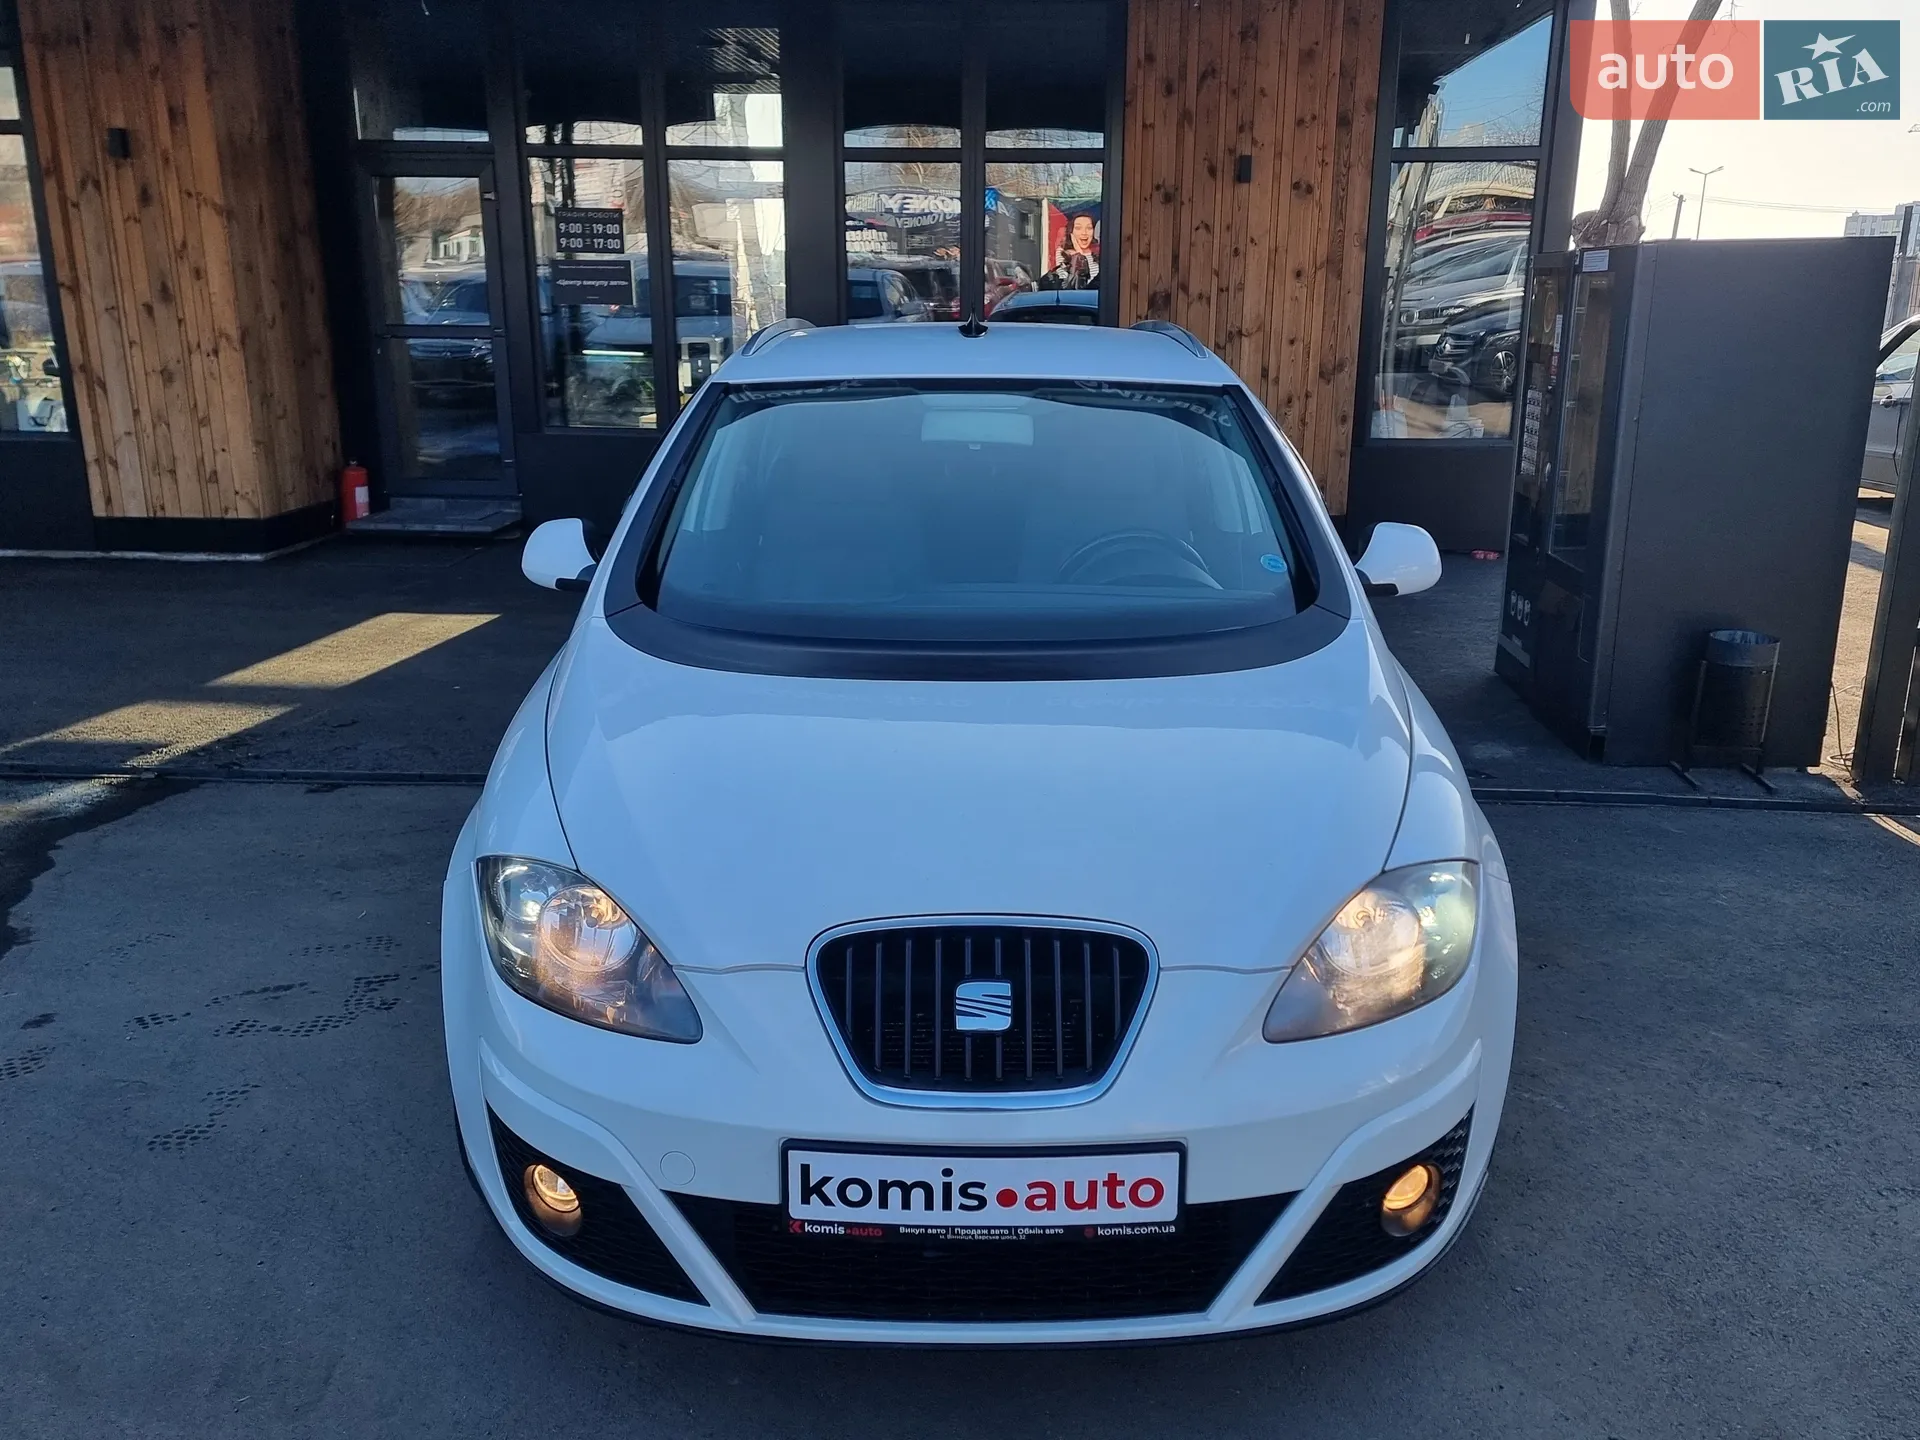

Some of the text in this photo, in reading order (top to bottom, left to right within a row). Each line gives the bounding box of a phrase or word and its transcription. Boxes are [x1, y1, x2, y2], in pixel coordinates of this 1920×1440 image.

[559, 223, 582, 233] 9:00
[592, 223, 620, 235] 19:00
[560, 238, 583, 248] 9:00
[593, 238, 621, 249] 17:00
[899, 1226, 925, 1236] Викуп
[955, 1227, 989, 1237] Продаж
[1017, 1227, 1044, 1235] Обмін
[1097, 1224, 1176, 1236] komis.com.ua
